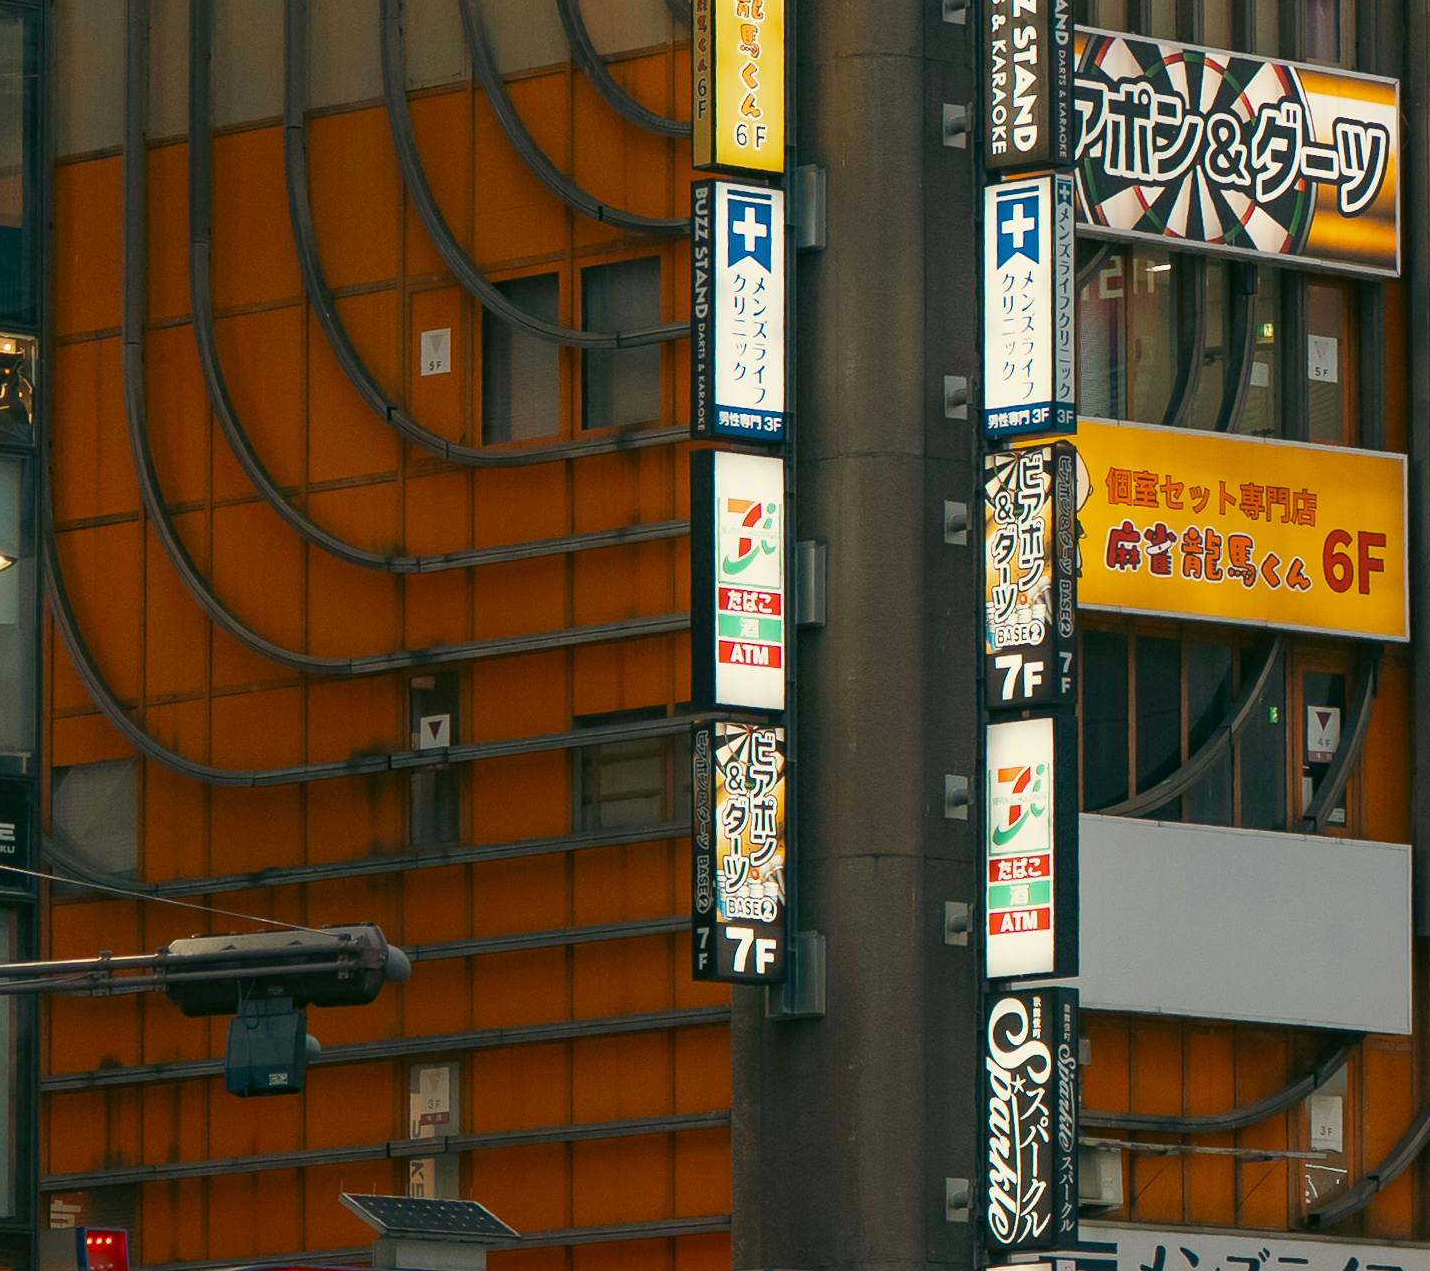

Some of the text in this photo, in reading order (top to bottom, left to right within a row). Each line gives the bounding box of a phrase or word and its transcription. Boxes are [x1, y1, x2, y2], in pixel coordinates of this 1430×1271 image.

[991, 39, 1007, 156] KARAOKE
[1012, 20, 1038, 154] STAND
[735, 122, 768, 149] 6F
[694, 187, 709, 319] BUZZ STAND
[732, 272, 747, 382] クリニック
[1001, 272, 1015, 382] クリニック
[1020, 270, 1036, 400] メンズライフ
[1058, 207, 1071, 401] メンズライフクリニック
[752, 274, 768, 405] メンズライフ
[718, 411, 782, 432] 男性専門 3F
[988, 407, 1050, 430] 男性専門 3F
[1057, 408, 1074, 425] 3F
[1017, 453, 1046, 592] ビアポン
[1105, 465, 1318, 527] 個室セット専門店
[1321, 529, 1388, 595] 6F
[726, 589, 773, 613] たばこ
[739, 616, 760, 639] 酒
[730, 643, 770, 667] ATM
[994, 654, 1045, 701] 7F
[750, 730, 779, 867] ビアポン
[996, 857, 1043, 881] たばこ
[724, 926, 778, 975] 7F
[1000, 910, 1038, 933] ATM
[1019, 1087, 1052, 1243] スパークル
